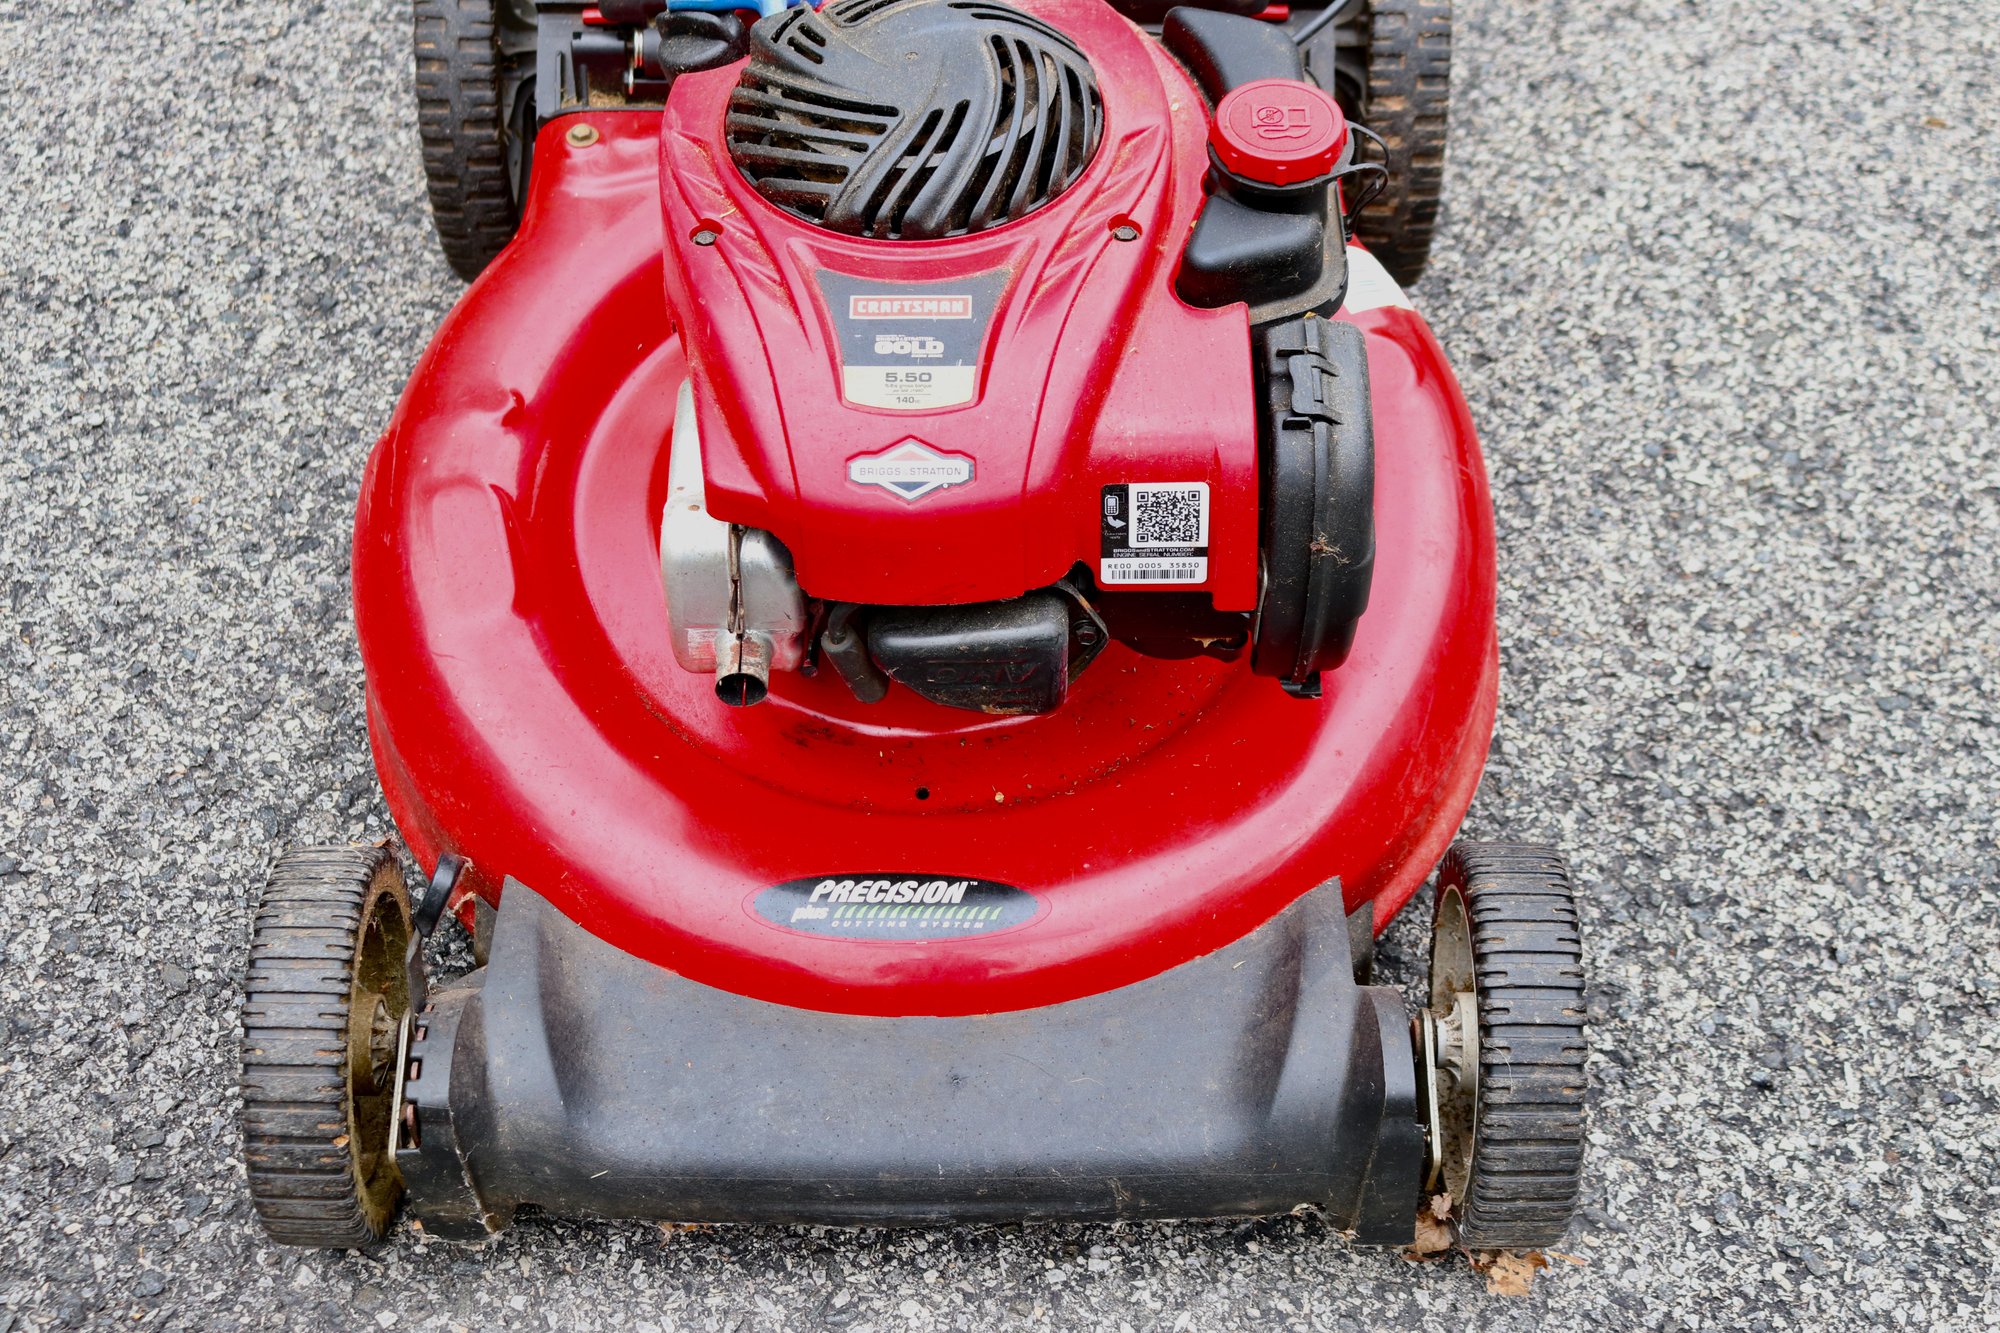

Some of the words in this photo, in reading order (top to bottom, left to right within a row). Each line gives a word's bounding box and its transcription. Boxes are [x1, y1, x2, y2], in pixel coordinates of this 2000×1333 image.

[856, 300, 964, 313] CRAFTSMAN
[885, 372, 932, 383] 5.50
[896, 396, 915, 404] 140
[859, 467, 901, 476] BRIGGS
[909, 467, 962, 476] STRATTON
[790, 905, 830, 923] plus
[831, 920, 907, 928] CUTTING
[920, 920, 985, 929] SYSTEM
